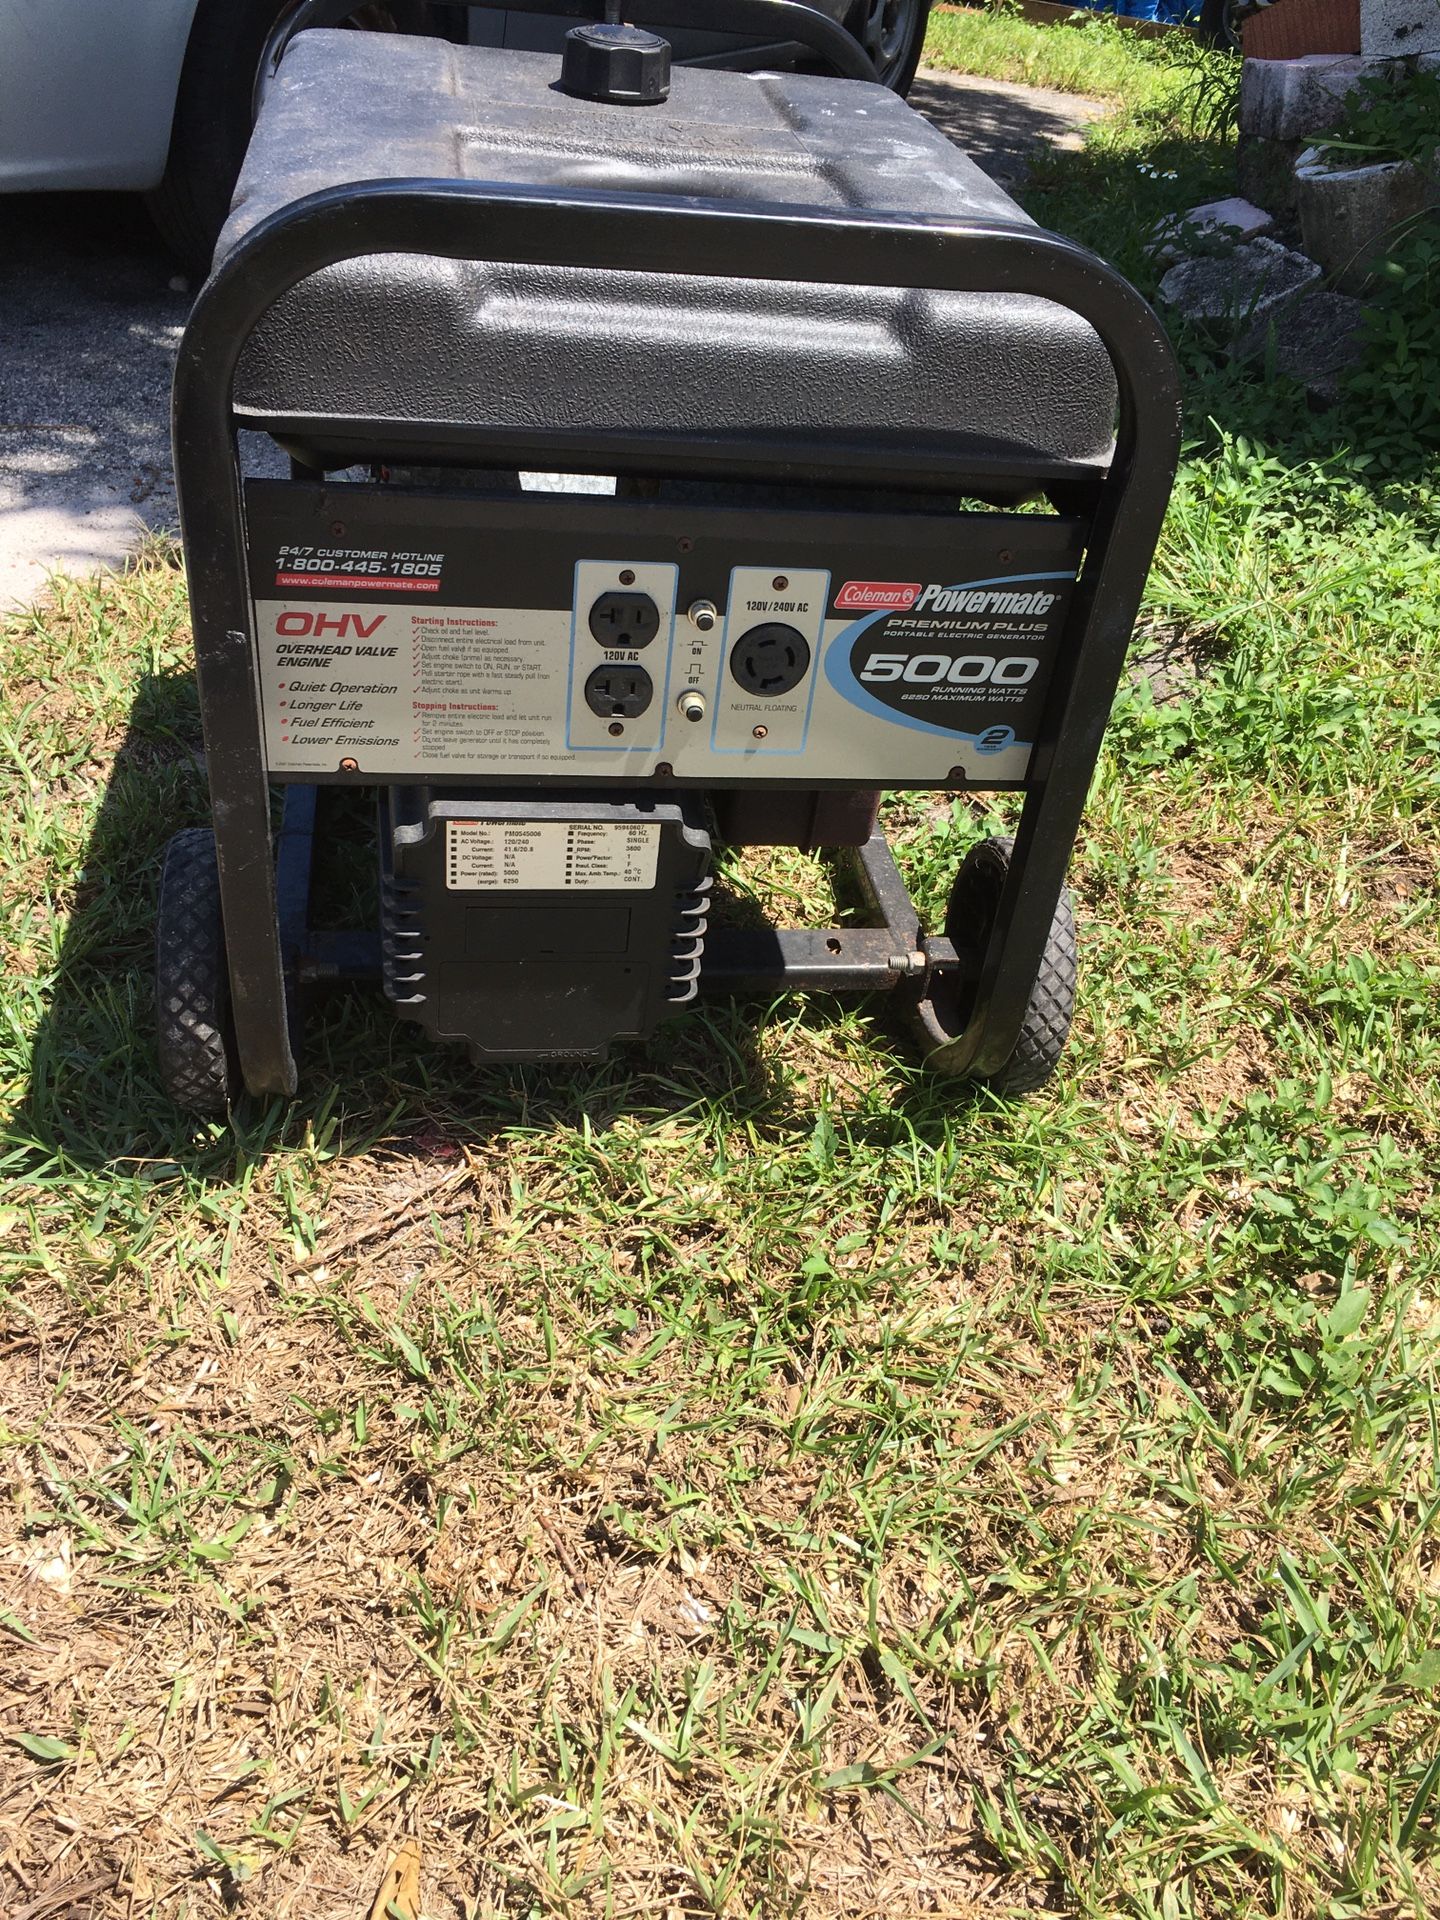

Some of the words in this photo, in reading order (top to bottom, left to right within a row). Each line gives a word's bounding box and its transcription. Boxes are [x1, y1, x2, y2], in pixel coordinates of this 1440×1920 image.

[279, 546, 314, 556] 24/7
[317, 548, 388, 560] CUSTOMER
[391, 552, 445, 562] HOTLINE
[275, 558, 442, 576] 1-800-445-1805
[281, 577, 439, 590] www.colemanpowermate.com
[844, 586, 899, 603] Coleman
[915, 584, 1055, 615] Powermate
[797, 603, 809, 613] AC
[275, 612, 387, 638] OHV
[411, 616, 444, 627] Starting
[447, 617, 498, 627] Instructions:
[886, 619, 992, 631] PREMIUM
[992, 622, 1049, 632] PLUS
[986, 633, 1045, 641] GENERATOR
[276, 644, 356, 656] OVERHEAD
[355, 646, 398, 657] VALVE
[604, 651, 625, 661] 120V
[627, 651, 639, 661] AC
[277, 657, 333, 668] ENGINE
[859, 653, 1040, 685] 5000
[289, 681, 327, 692] Quiet
[330, 682, 398, 695] Operation
[931, 686, 986, 694] RUNNING
[931, 694, 987, 702] MAXIMUM
[987, 695, 1024, 703] WATTS
[289, 700, 337, 712] Longer
[339, 700, 363, 711] Life
[412, 702, 447, 711] Stopping
[731, 704, 763, 712] NEUTRAL
[764, 704, 797, 712] FLOATING
[290, 717, 320, 727] Fuel
[321, 718, 375, 728] Efficient
[292, 735, 333, 745] Lower
[335, 735, 400, 746] Emissions
[980, 730, 1010, 744] 2
